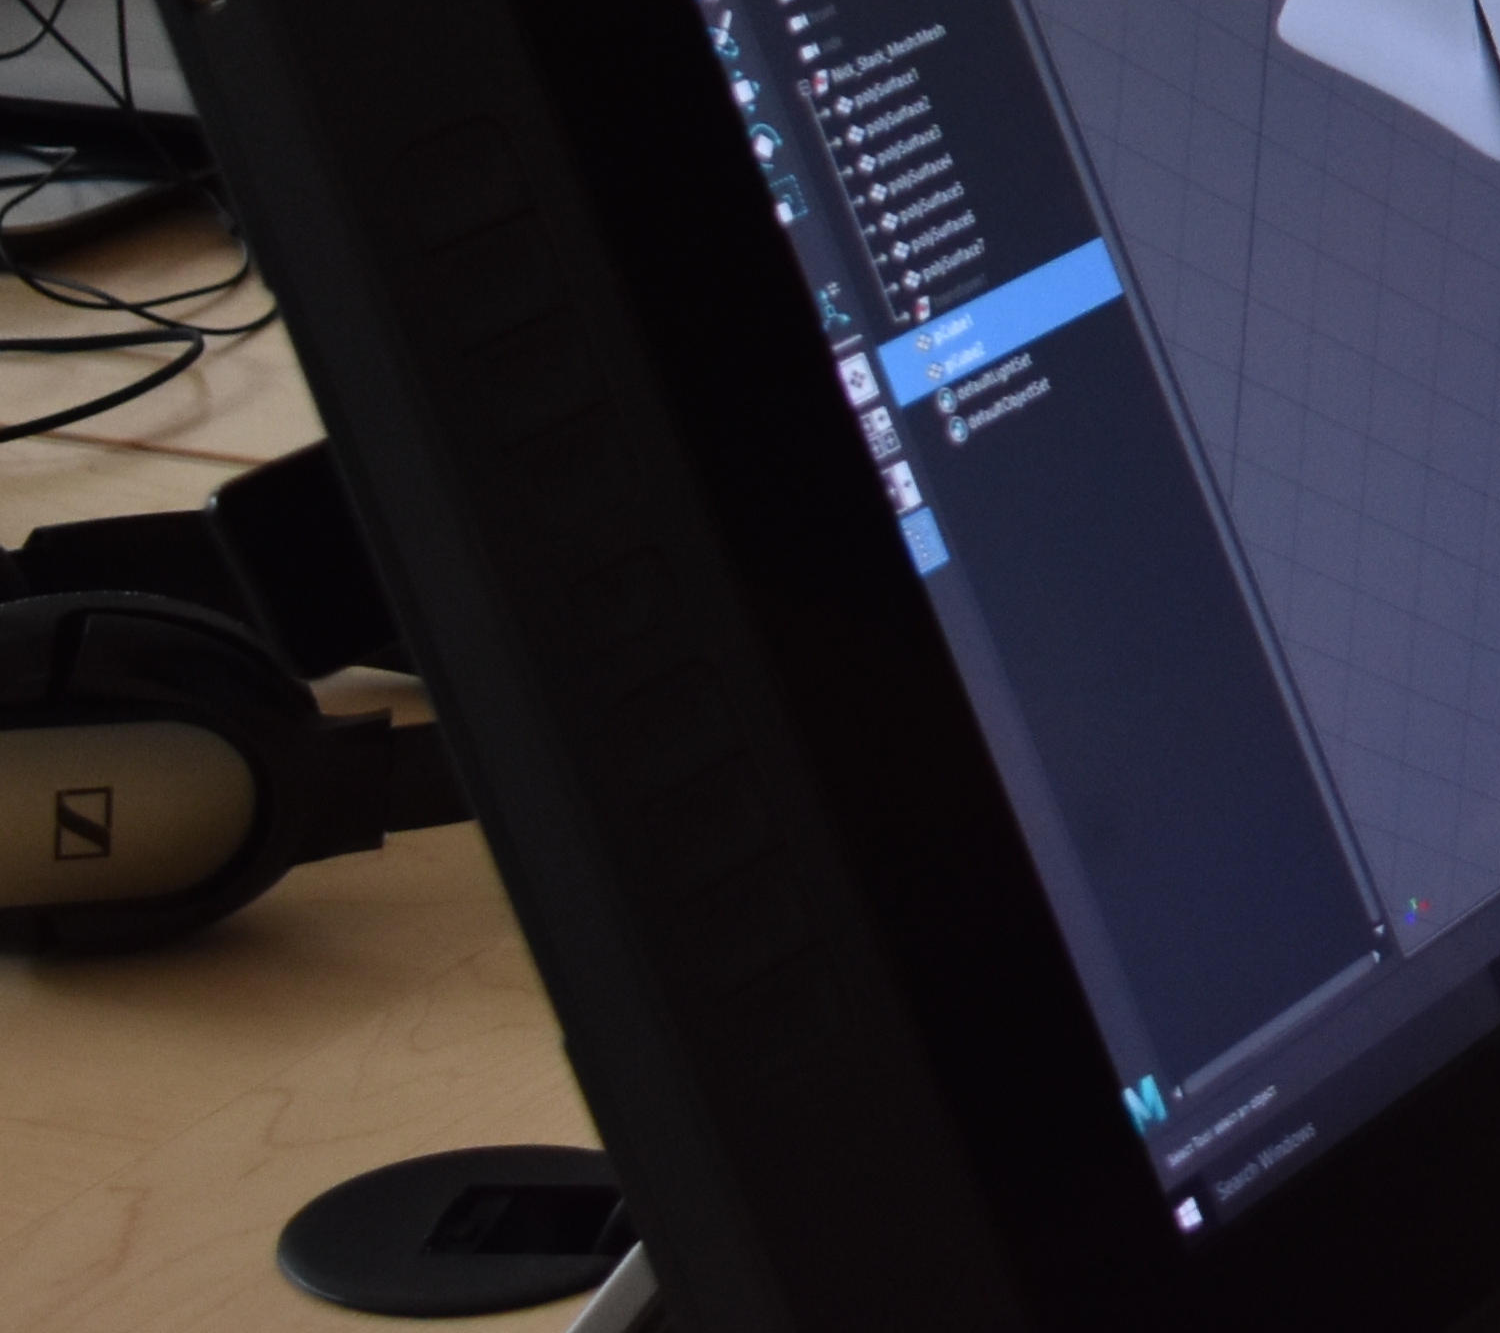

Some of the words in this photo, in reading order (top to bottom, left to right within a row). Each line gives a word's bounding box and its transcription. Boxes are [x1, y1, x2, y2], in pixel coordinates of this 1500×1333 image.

[852, 66, 922, 109] polySurface1
[864, 95, 933, 138] polySurface2
[875, 124, 944, 168] polySurface3
[886, 152, 956, 197] polySurface4
[898, 180, 967, 225] polySurface5
[909, 209, 978, 254] polySurface6
[920, 237, 989, 283] polySurface7
[1215, 1157, 1260, 1202] Search
[1257, 1117, 1317, 1172] Windows
